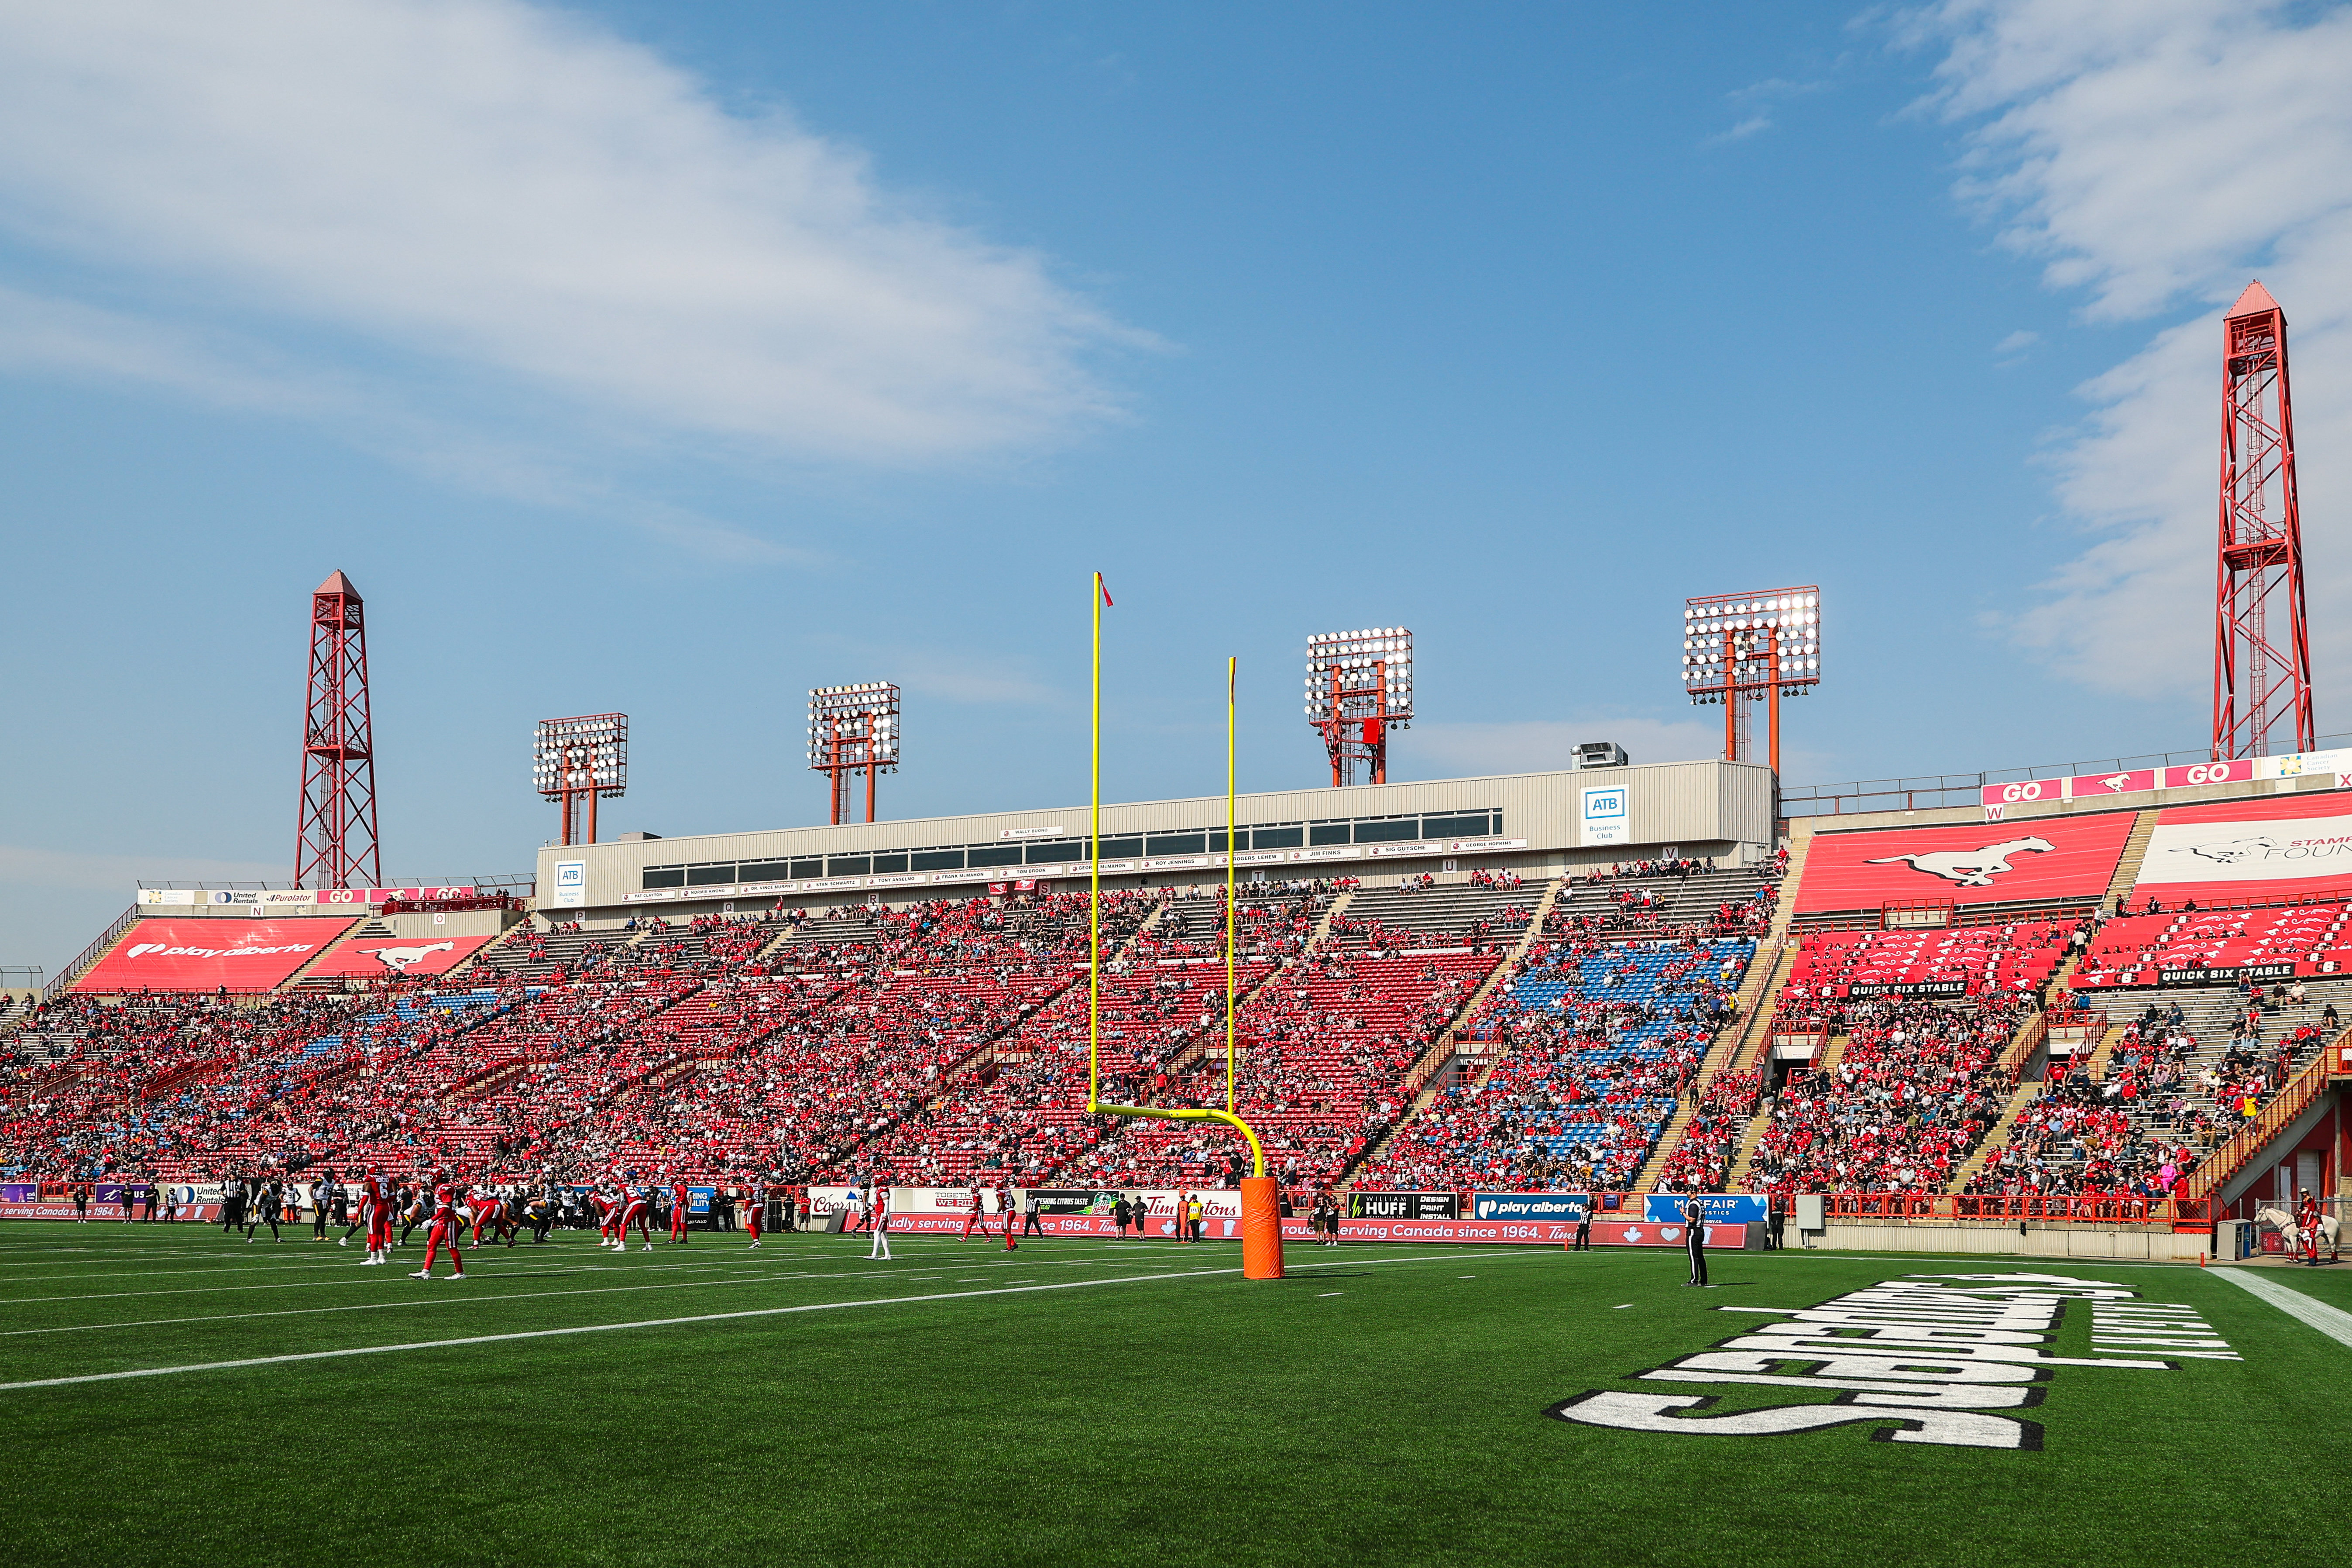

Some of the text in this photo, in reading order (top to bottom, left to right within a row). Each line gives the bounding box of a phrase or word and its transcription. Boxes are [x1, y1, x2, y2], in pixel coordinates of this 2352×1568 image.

[2187, 763, 2230, 784] GO
[2340, 774, 2352, 787] X
[2002, 782, 2042, 802] GO
[1593, 798, 1617, 811] ATB
[1987, 807, 2002, 819] W
[1665, 848, 1676, 859] V
[1446, 861, 1454, 871] U
[563, 870, 579, 880] ATB
[1254, 871, 1262, 881] T
[1041, 884, 1048, 893] S
[274, 894, 311, 902] Purolator
[329, 890, 354, 903] GO
[870, 894, 876, 903] R
[725, 903, 732, 912] Q
[577, 912, 584, 920] P
[160, 944, 314, 958] play alberta
[2162, 965, 2291, 981] QUICK SIX STABLE
[2315, 961, 2342, 973] Q6S
[2114, 973, 2139, 984] Q6S
[1852, 982, 1964, 995] QUICK SIX STABLE
[323, 1187, 331, 1195] 19
[379, 1182, 388, 1199] 6
[196, 1196, 226, 1204] Rentals
[1147, 1196, 1173, 1215] Tim
[1674, 1200, 1736, 1208] MFAIR
[4, 1207, 34, 1217] serving
[36, 1206, 69, 1216] Canada
[94, 1207, 114, 1216] 1964.
[1366, 1202, 1406, 1215] HUFF
[1497, 1201, 1583, 1215] play alberta
[870, 1217, 917, 1231] Pudly
[918, 1217, 963, 1231] serving
[1060, 1219, 1093, 1232] 1964.
[1337, 1224, 1388, 1239] serving
[1392, 1224, 1454, 1237] Canada
[1457, 1225, 1497, 1238] since
[1502, 1225, 1542, 1239] 1964.
[1548, 1225, 1577, 1239] Tims
[2091, 1300, 2245, 1361] CALGARY
